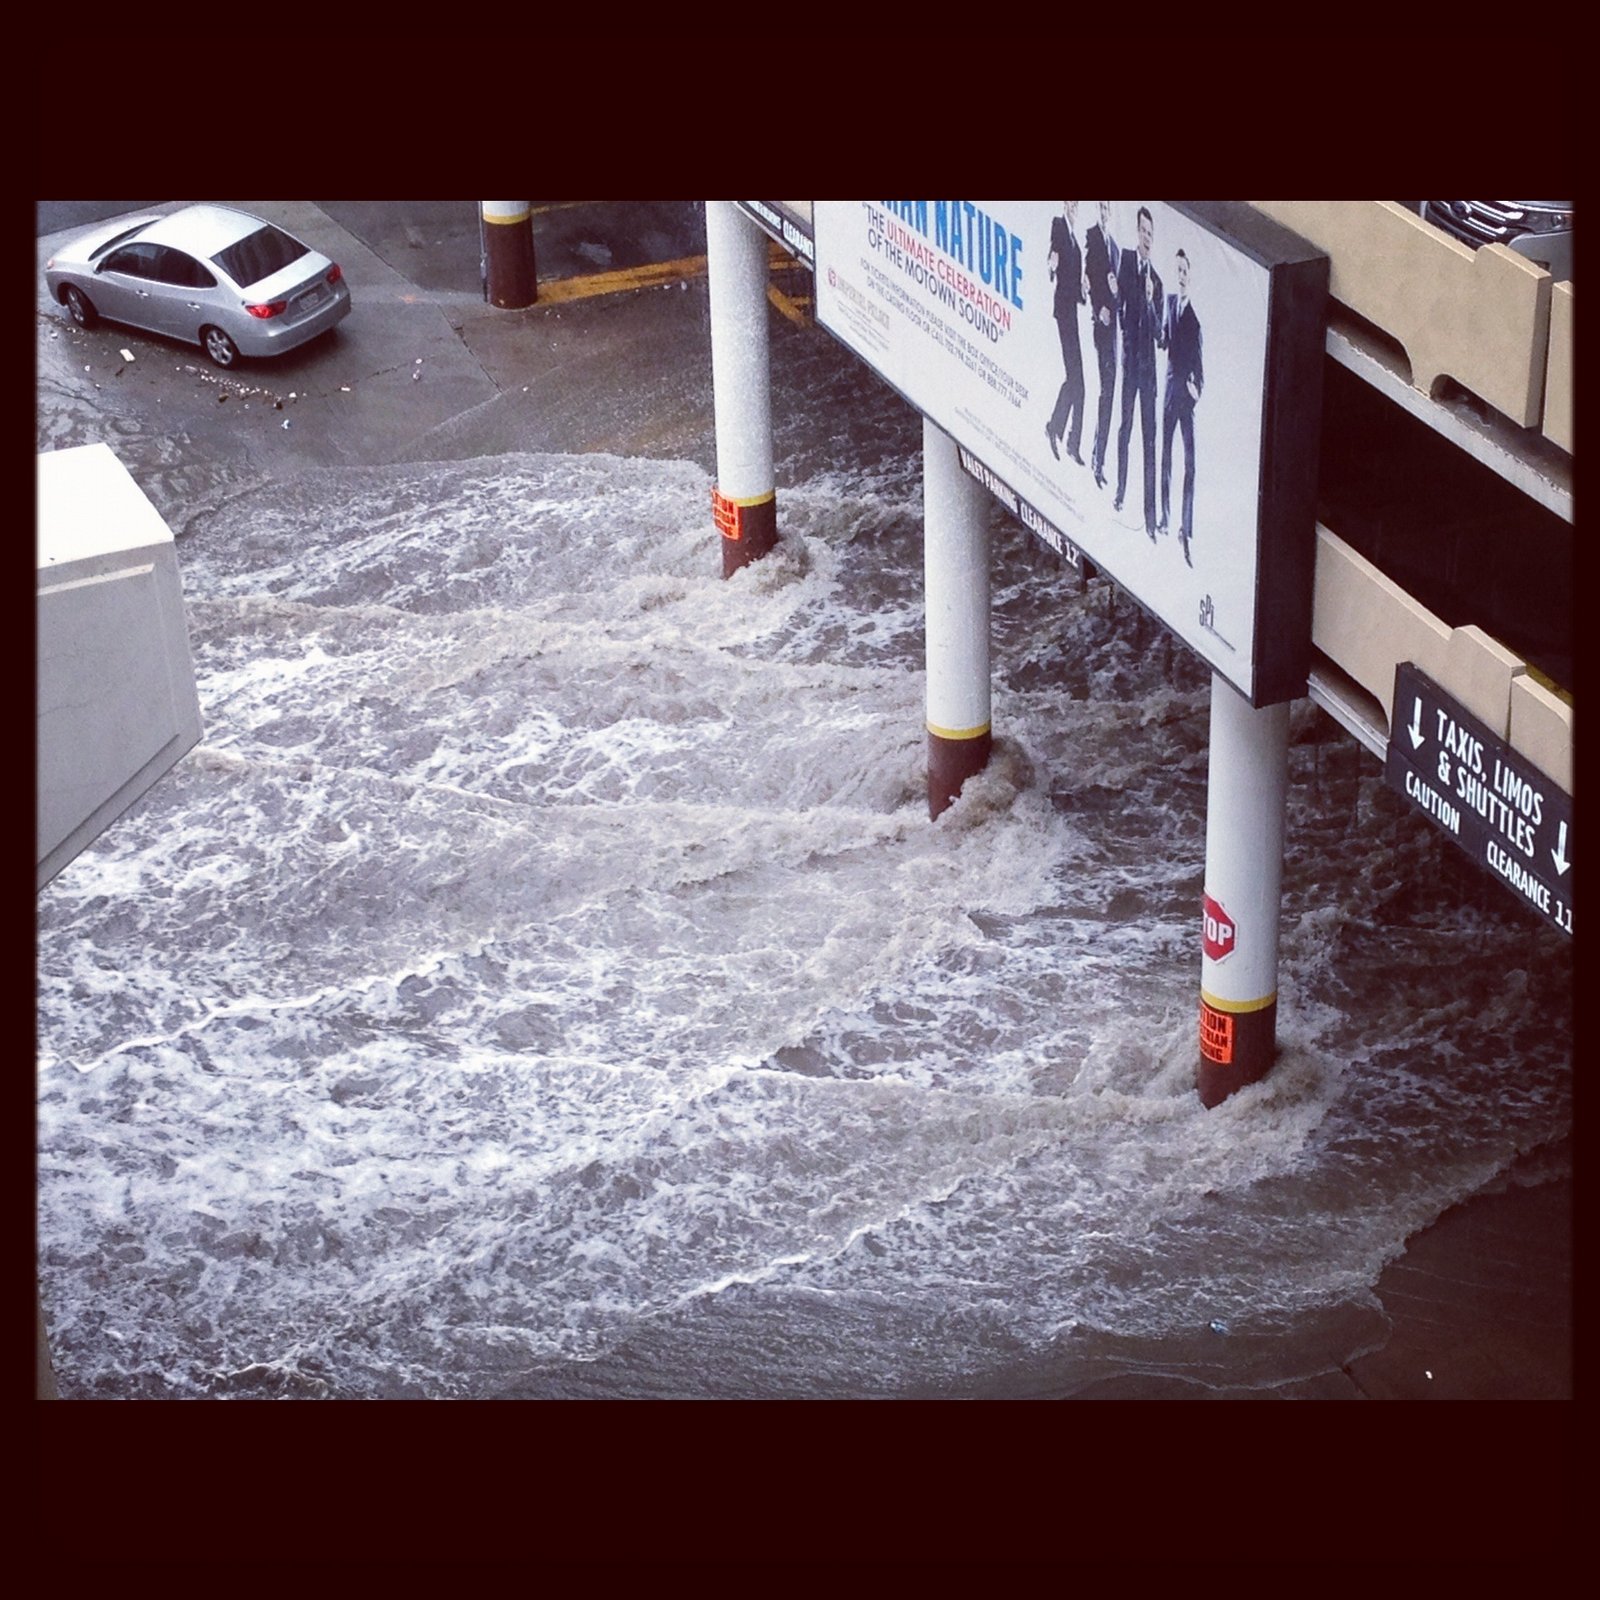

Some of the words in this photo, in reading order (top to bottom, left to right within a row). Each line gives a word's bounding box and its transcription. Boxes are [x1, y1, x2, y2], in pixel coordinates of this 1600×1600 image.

[868, 228, 882, 252] OF
[885, 238, 902, 270] THE
[905, 255, 956, 311] MOTOWN
[886, 219, 935, 273] ULTIMATE
[938, 258, 1011, 332] CELEBRATION
[935, 201, 1023, 311] NATURE
[967, 341, 978, 359] BOX
[1405, 771, 1461, 835] CAUTION
[1437, 708, 1487, 782] TAXIS,
[1494, 760, 1544, 826] LIMOS
[1437, 751, 1451, 786] &
[1456, 766, 1535, 858] SHUTTLES
[1487, 840, 1551, 914] CLEARANCE
[1203, 909, 1233, 946] TOP
